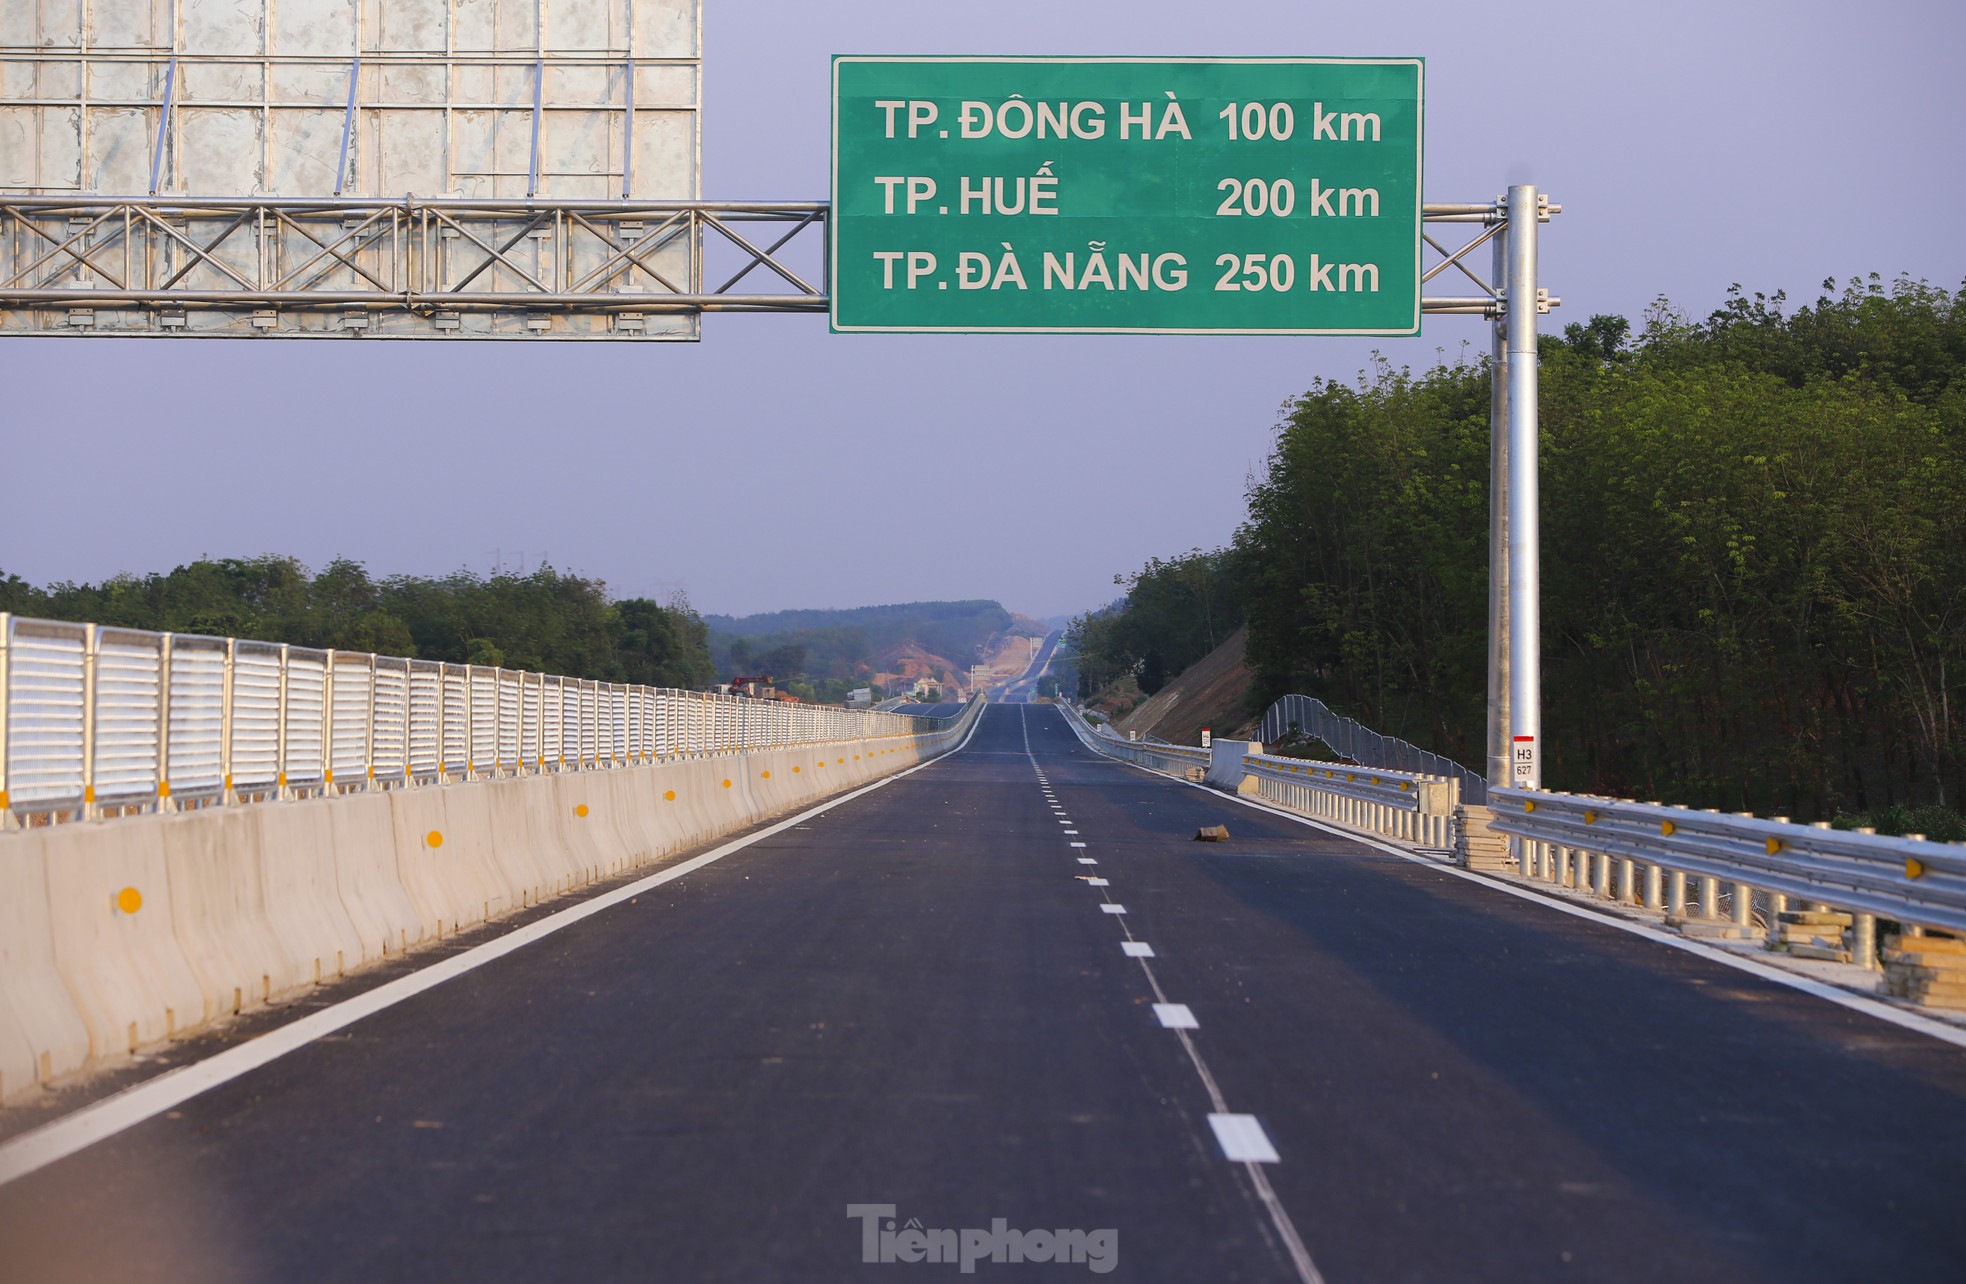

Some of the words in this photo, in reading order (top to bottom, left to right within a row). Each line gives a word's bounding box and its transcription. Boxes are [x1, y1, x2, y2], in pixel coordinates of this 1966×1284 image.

[957, 93, 1106, 140] ĐÔNG
[1120, 90, 1193, 140] HÀ
[1219, 101, 1294, 141] 100
[1313, 101, 1381, 142] km
[960, 160, 1059, 216] HUẾ
[1216, 177, 1295, 217] 200
[1310, 178, 1380, 217] km
[955, 241, 1028, 290] ĐÀ
[1043, 240, 1188, 292] NẴNG
[1214, 253, 1295, 293] 250
[1310, 253, 1379, 293] km
[1516, 765, 1532, 775] 627
[1517, 749, 1532, 760] H3
